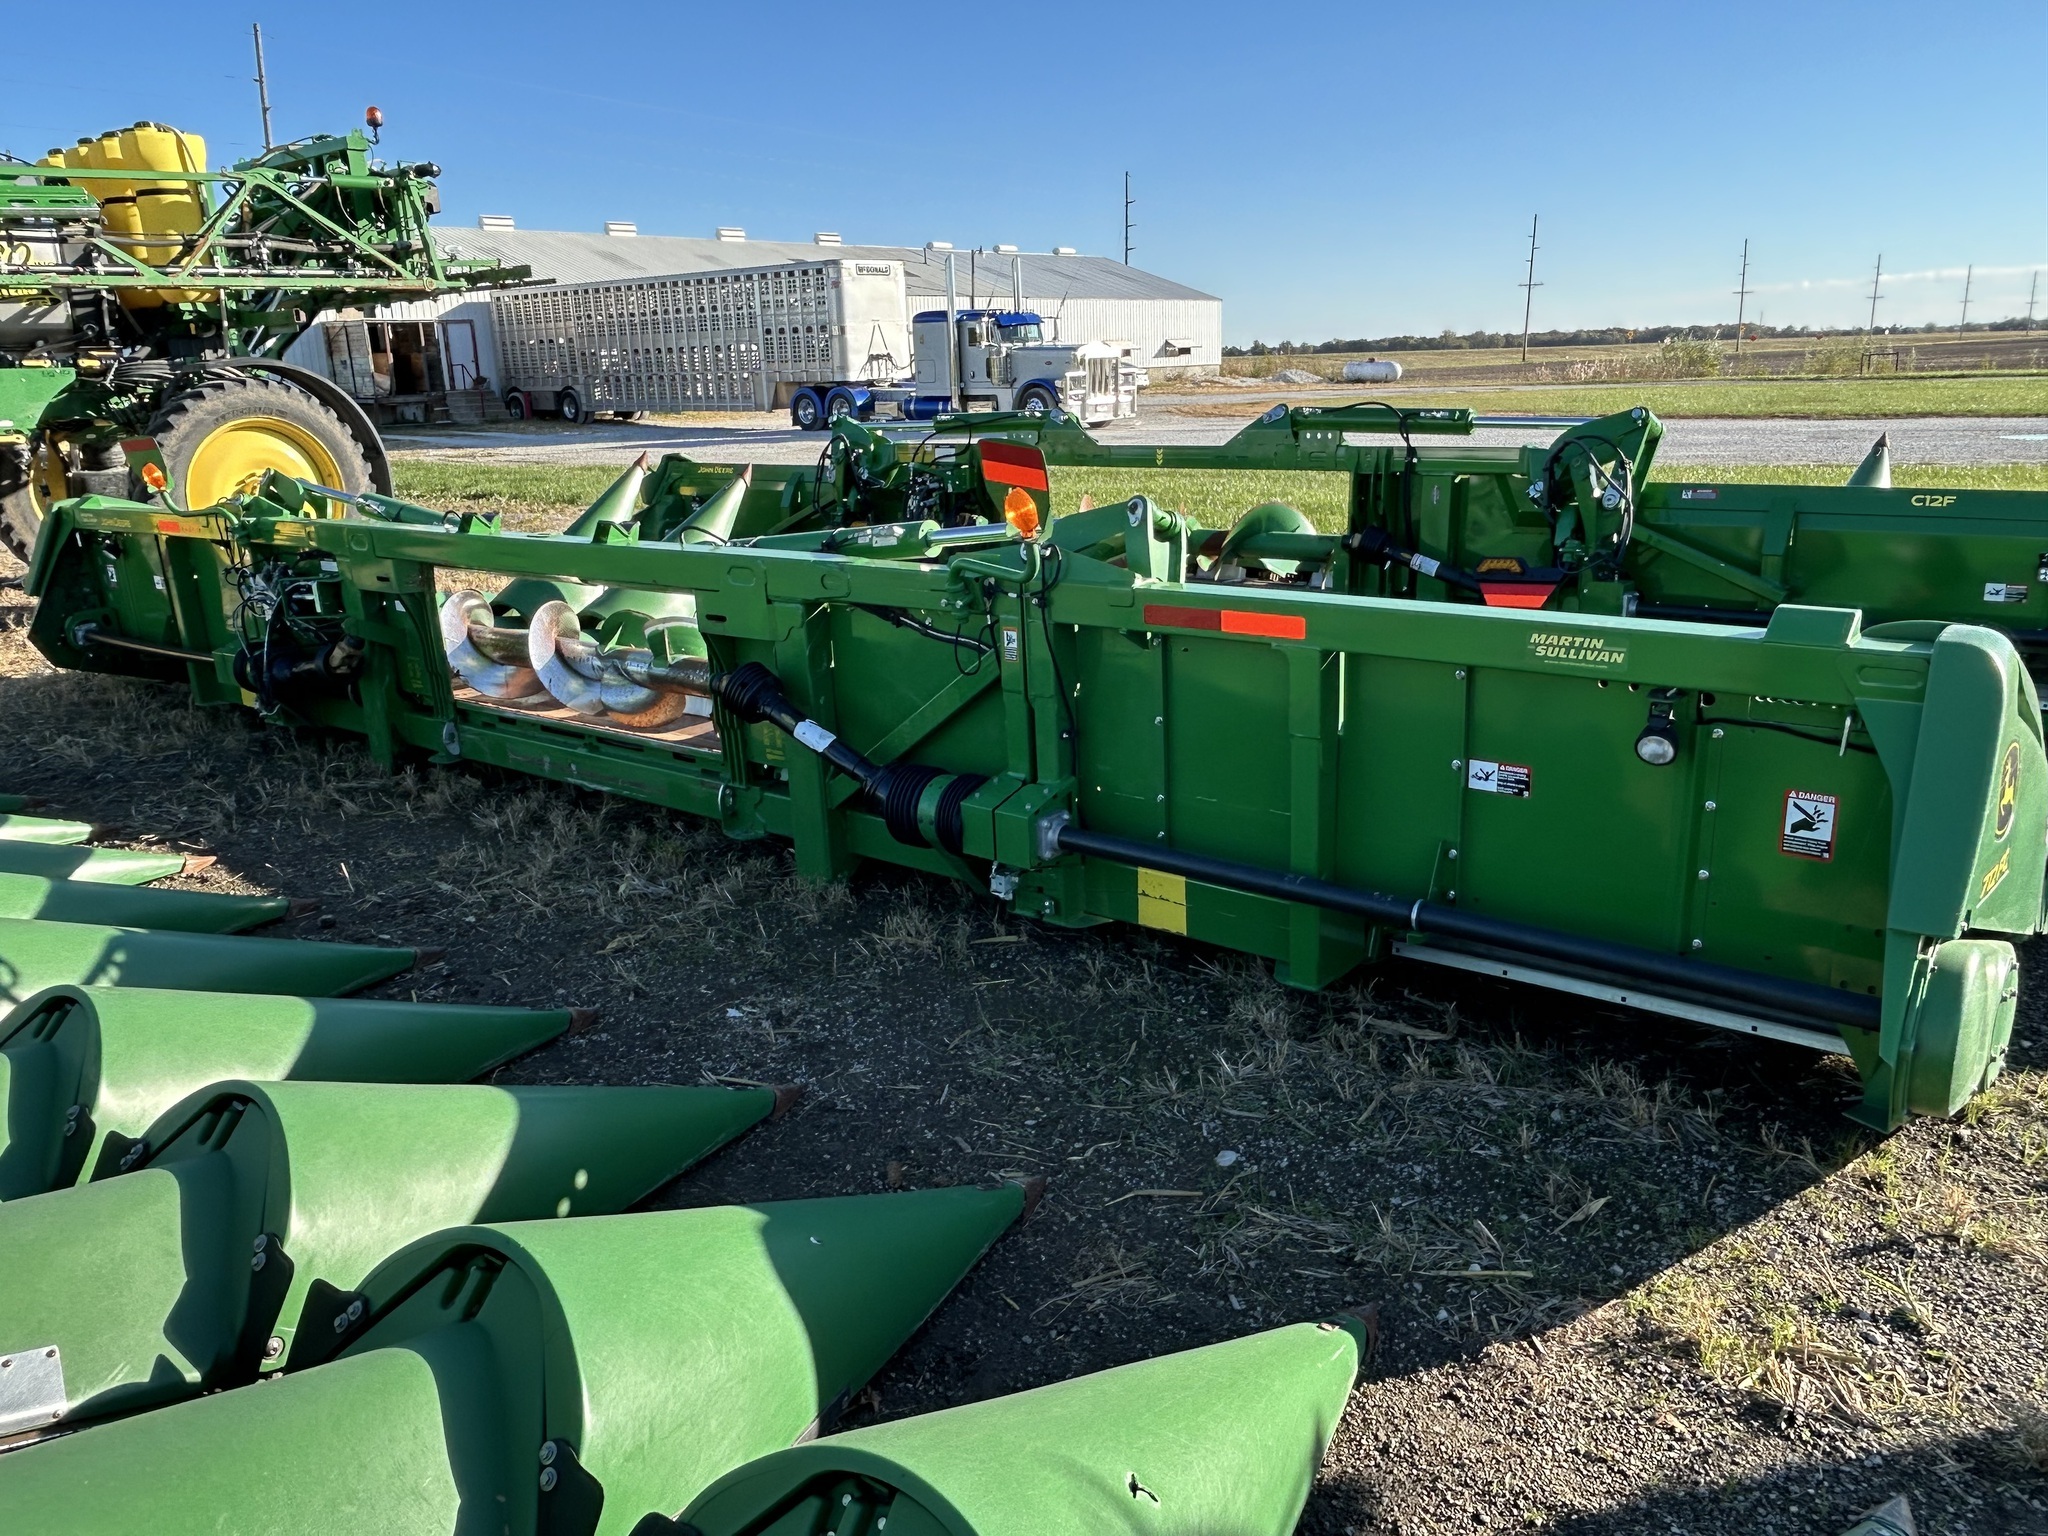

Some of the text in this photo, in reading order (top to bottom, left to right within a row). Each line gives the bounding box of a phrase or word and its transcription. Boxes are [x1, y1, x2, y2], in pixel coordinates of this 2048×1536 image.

[1911, 494, 1957, 507] C12F
[1529, 633, 1604, 649] MARTIN
[1535, 645, 1625, 664] SULLIVAN
[1798, 791, 1836, 804] DANGER
